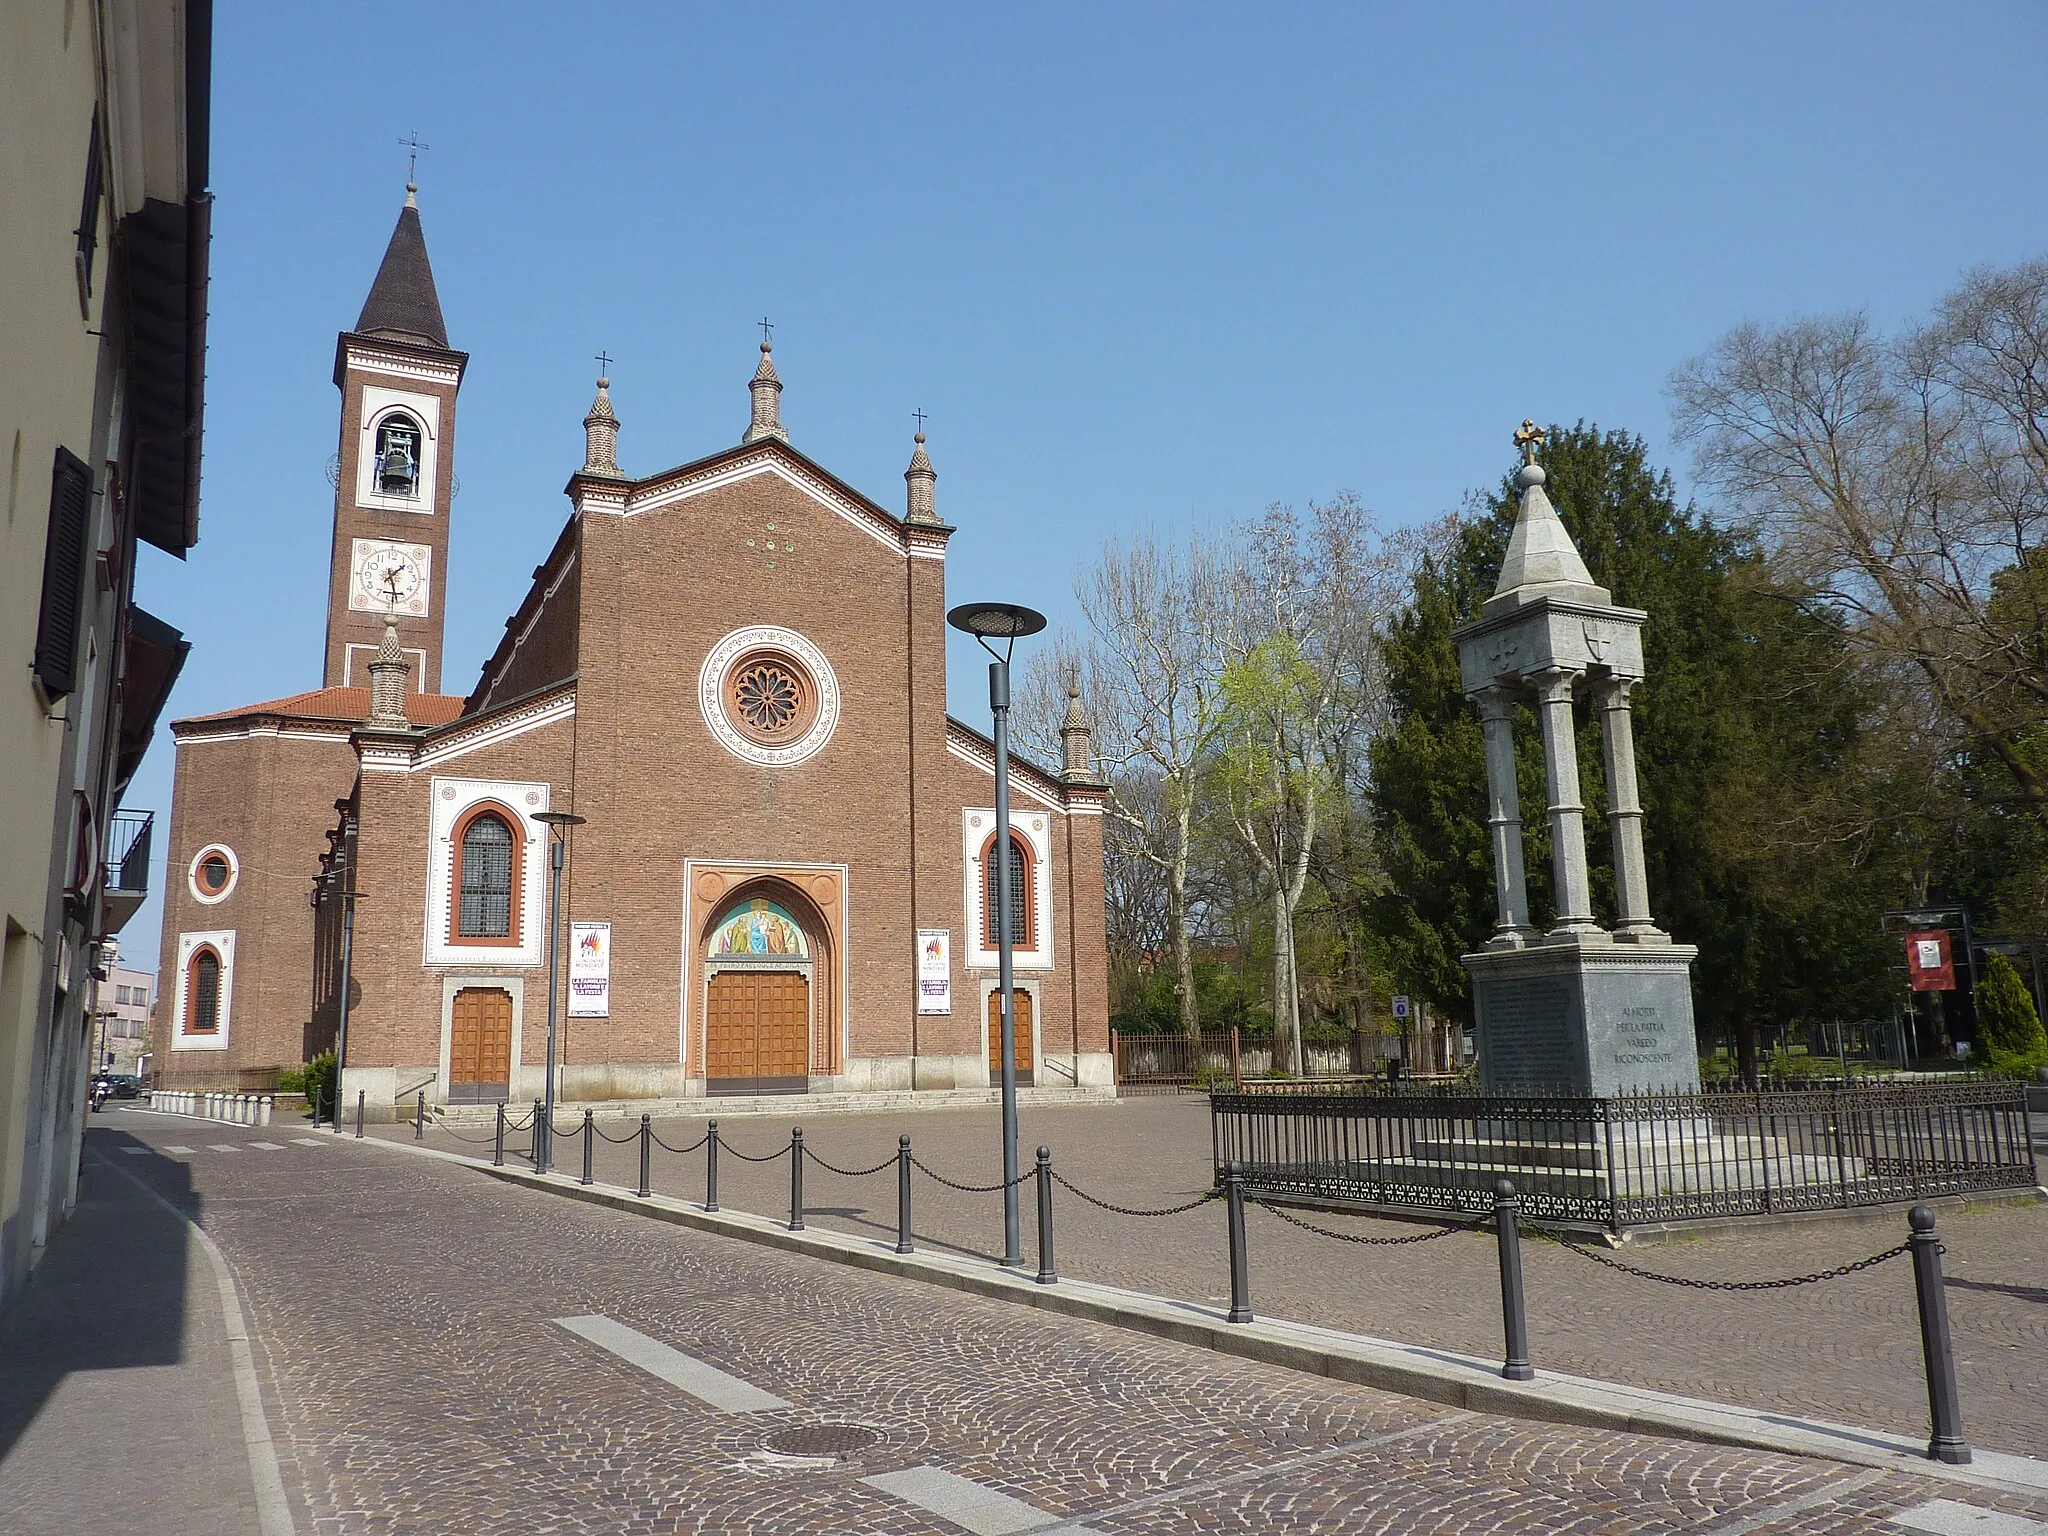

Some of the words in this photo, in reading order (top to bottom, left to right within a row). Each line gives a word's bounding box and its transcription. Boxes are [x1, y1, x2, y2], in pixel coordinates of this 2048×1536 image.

[377, 555, 384, 563] 11
[388, 552, 398, 560] 12
[367, 562, 378, 570] 10
[407, 565, 413, 573] 2
[367, 581, 373, 589] 8
[1632, 1007, 1655, 1016] MORTI
[1616, 1023, 1630, 1032] PER
[1631, 1023, 1641, 1032] LA
[1641, 1023, 1665, 1032] PATRIA
[1627, 1038, 1657, 1047] VAREDO
[1614, 1054, 1672, 1064] RICONOSCENTE
